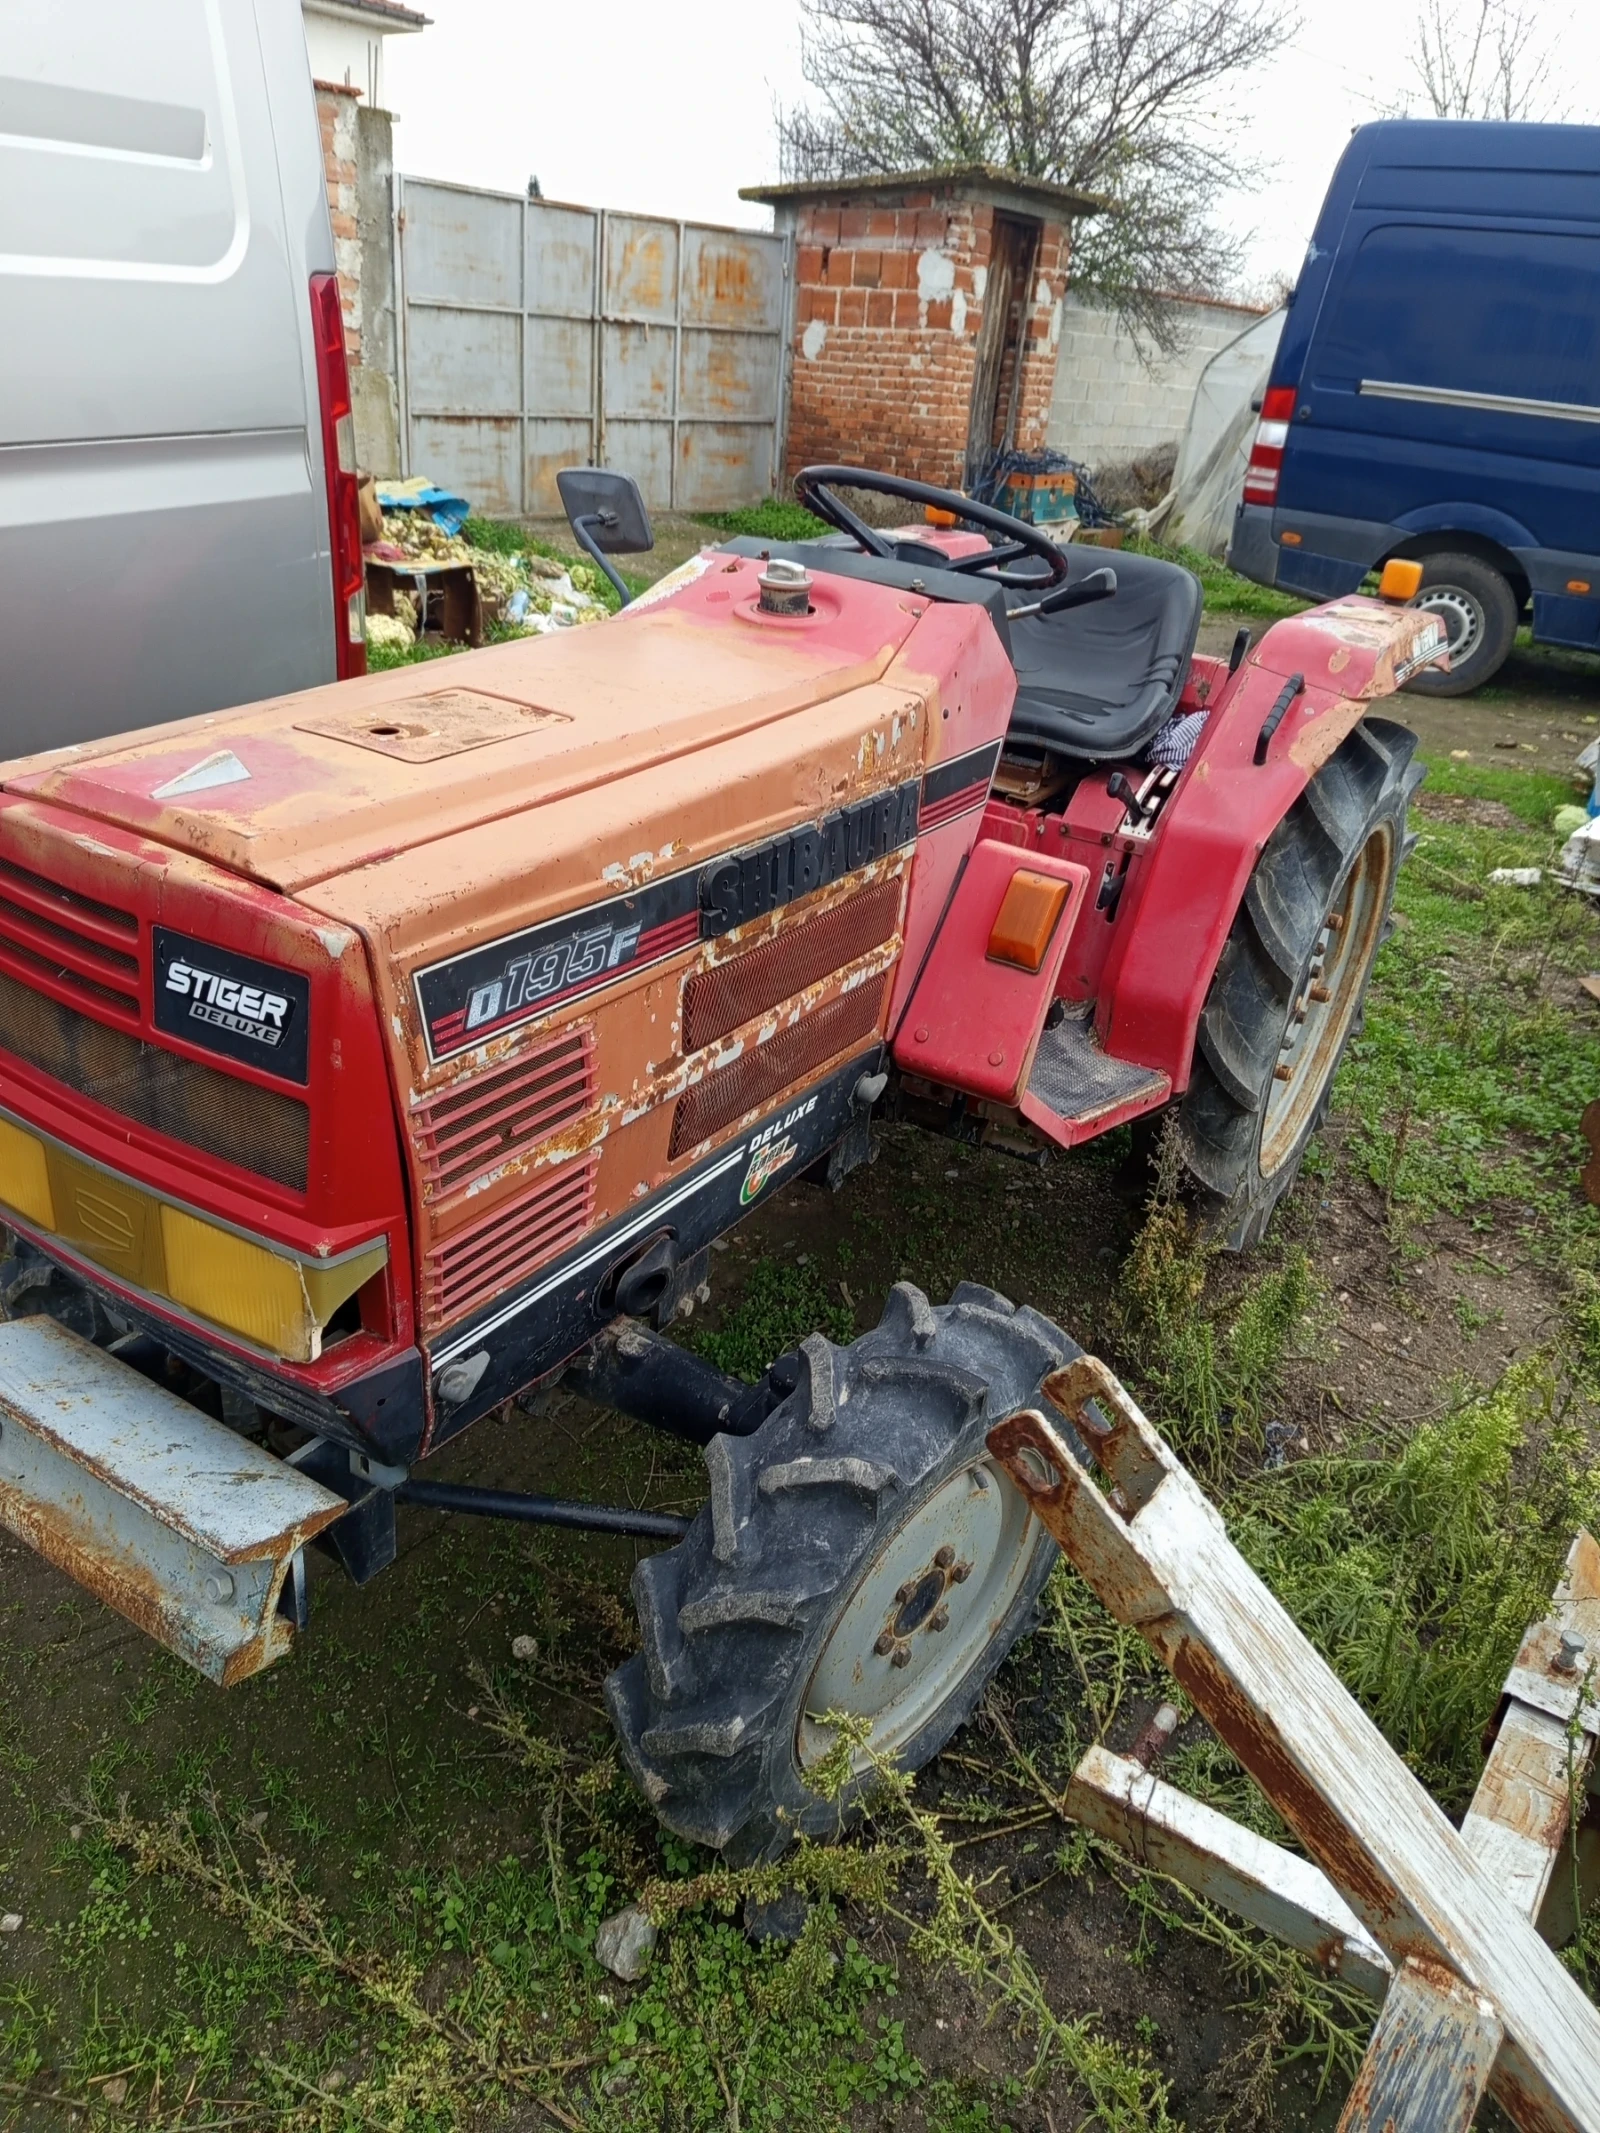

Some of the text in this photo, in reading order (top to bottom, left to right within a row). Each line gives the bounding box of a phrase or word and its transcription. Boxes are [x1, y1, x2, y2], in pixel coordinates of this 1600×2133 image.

[701, 780, 919, 937] SHIBAURA
[165, 961, 288, 1028] STIGER
[191, 1003, 281, 1045] DELUXE
[749, 1095, 818, 1153] DELUXE
